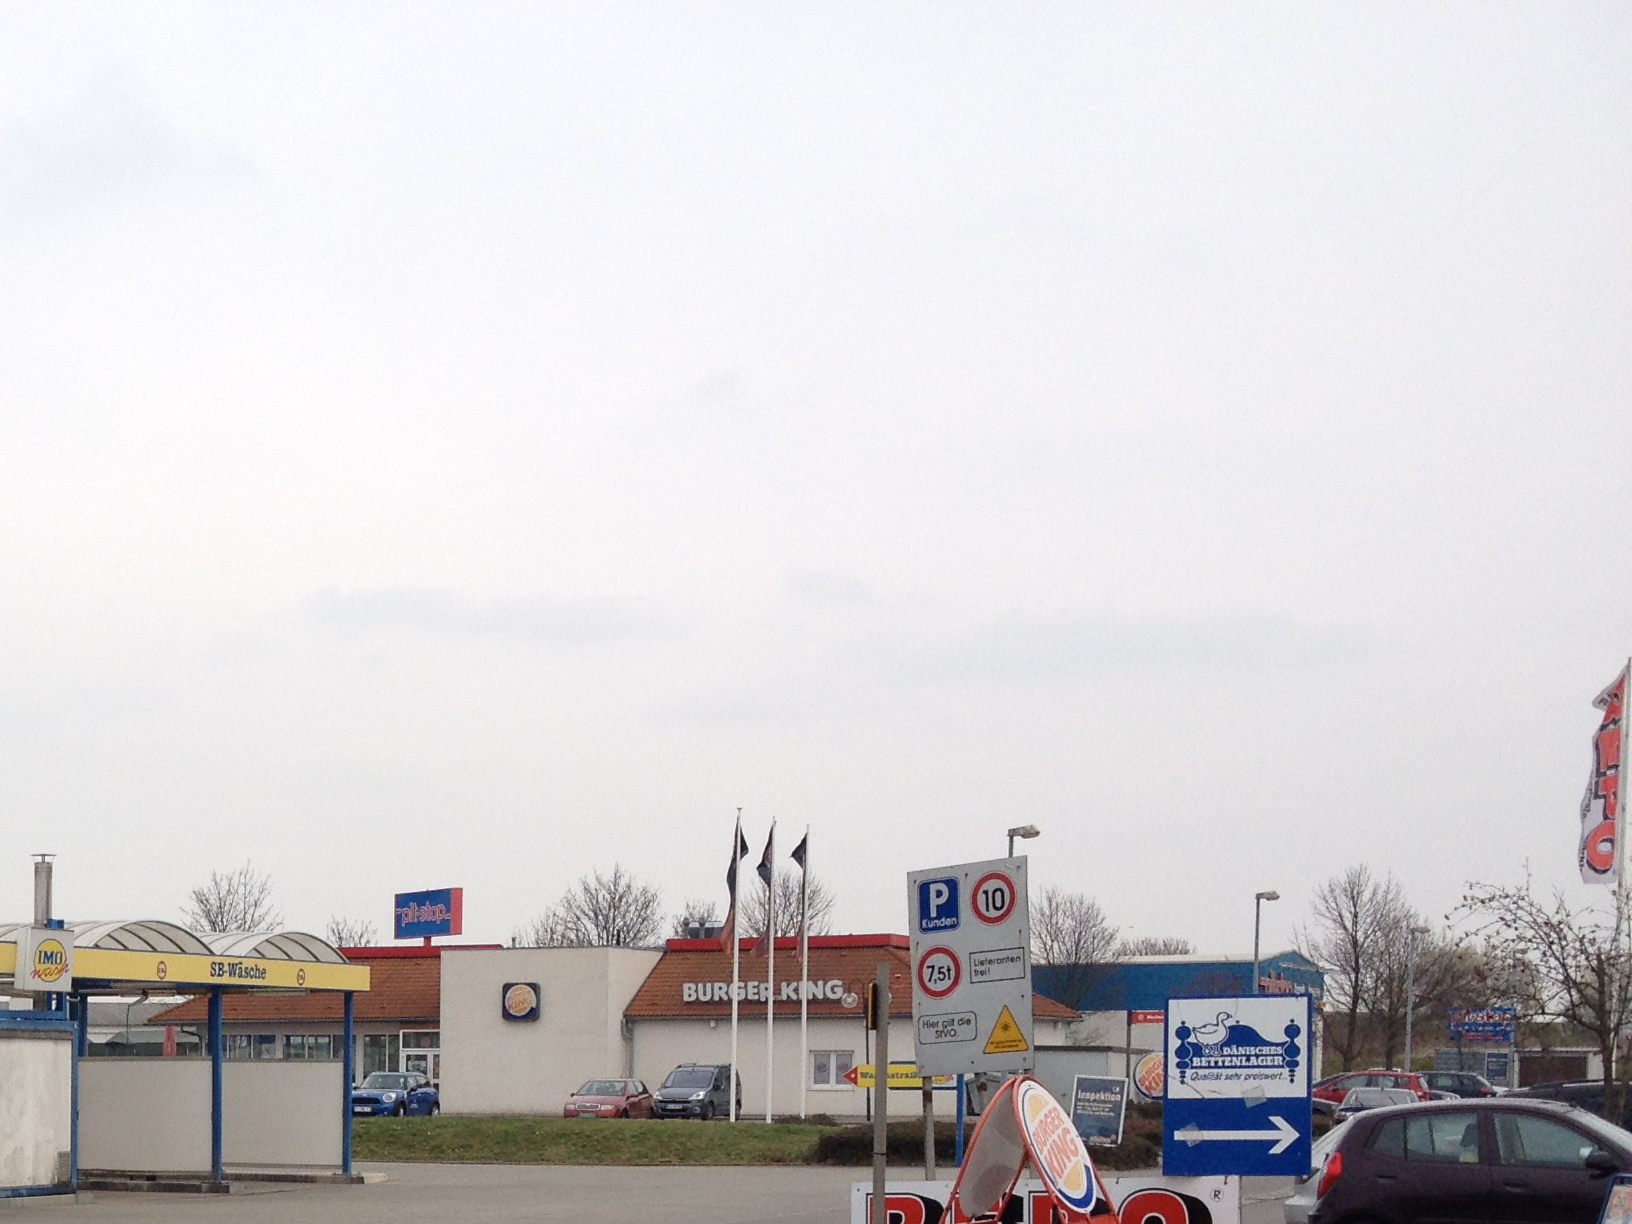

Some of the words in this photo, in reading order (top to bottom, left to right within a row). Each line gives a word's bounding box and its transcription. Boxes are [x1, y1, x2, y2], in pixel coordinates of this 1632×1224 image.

[929, 882, 950, 918] P
[982, 887, 1005, 912] 10
[922, 917, 957, 928] Kunden
[38, 950, 63, 965] IMO
[974, 955, 1021, 967] Lieferanten
[210, 961, 267, 980] SB-Wäsche
[926, 965, 952, 984] 7,5t
[683, 981, 773, 1002] BURGER
[781, 980, 843, 1000] KING
[922, 1020, 939, 1029] Hier
[1223, 1045, 1283, 1055] DÄNISCHES
[1192, 1056, 1283, 1067] BETTENLAGER
[1190, 1071, 1222, 1081] Qualität
[1224, 1072, 1243, 1080] sehr
[1078, 1090, 1121, 1101] Inspektion
[1033, 1107, 1064, 1155] BURGER
[1045, 1127, 1079, 1185] KING
